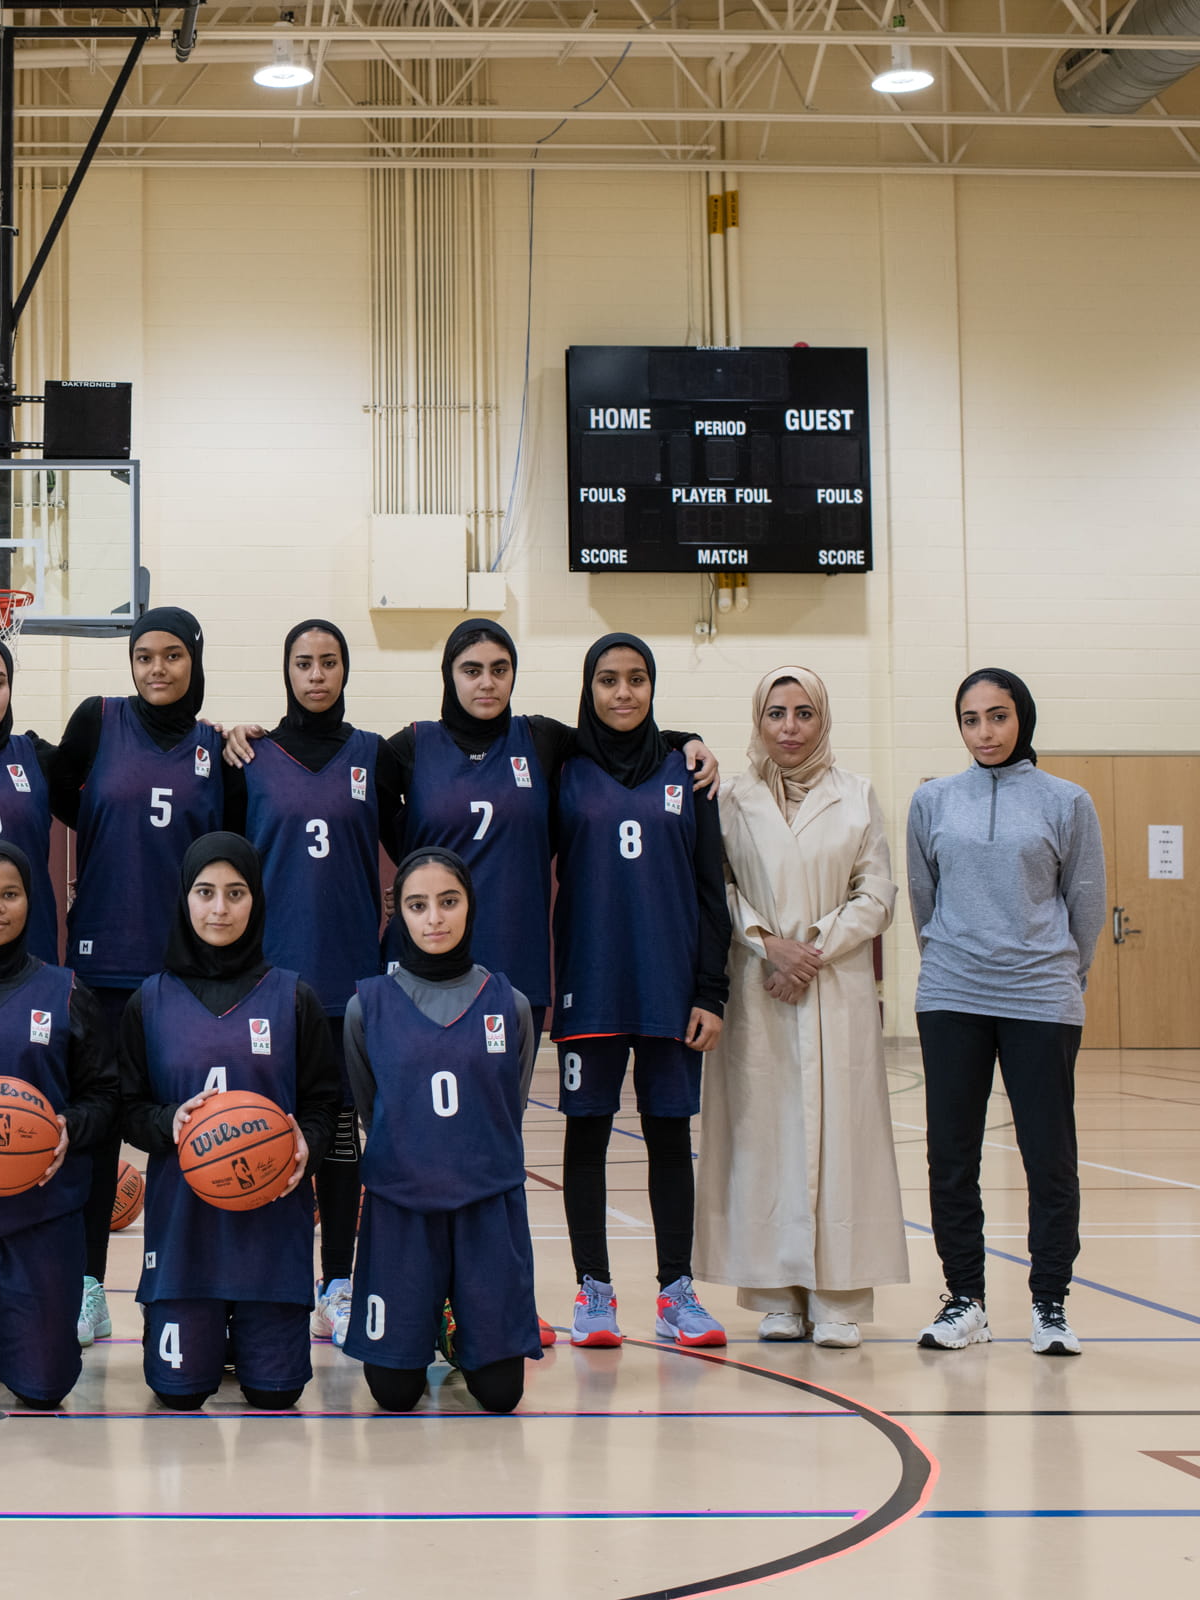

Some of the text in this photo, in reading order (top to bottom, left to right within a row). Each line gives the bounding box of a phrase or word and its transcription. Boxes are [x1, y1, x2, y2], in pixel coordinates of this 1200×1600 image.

[589, 408, 652, 430] HOME
[694, 420, 747, 436] PERIOD
[784, 408, 854, 431] GUEST
[579, 487, 627, 502] FOULS
[671, 488, 773, 503] PLAYER FOUL
[816, 488, 863, 504] FOULS
[580, 549, 628, 565] SCORE
[697, 549, 749, 565] MATCH
[818, 550, 866, 565] SCORE
[150, 787, 173, 828] 5
[470, 801, 493, 840] 7
[305, 818, 330, 858] 3
[619, 820, 642, 859] 8
[253, 1041, 270, 1049] UAE
[564, 1052, 582, 1091] 8
[431, 1070, 459, 1117] 0
[190, 1118, 269, 1157] Wilson
[365, 1294, 385, 1341] 0
[159, 1322, 183, 1369] 4
